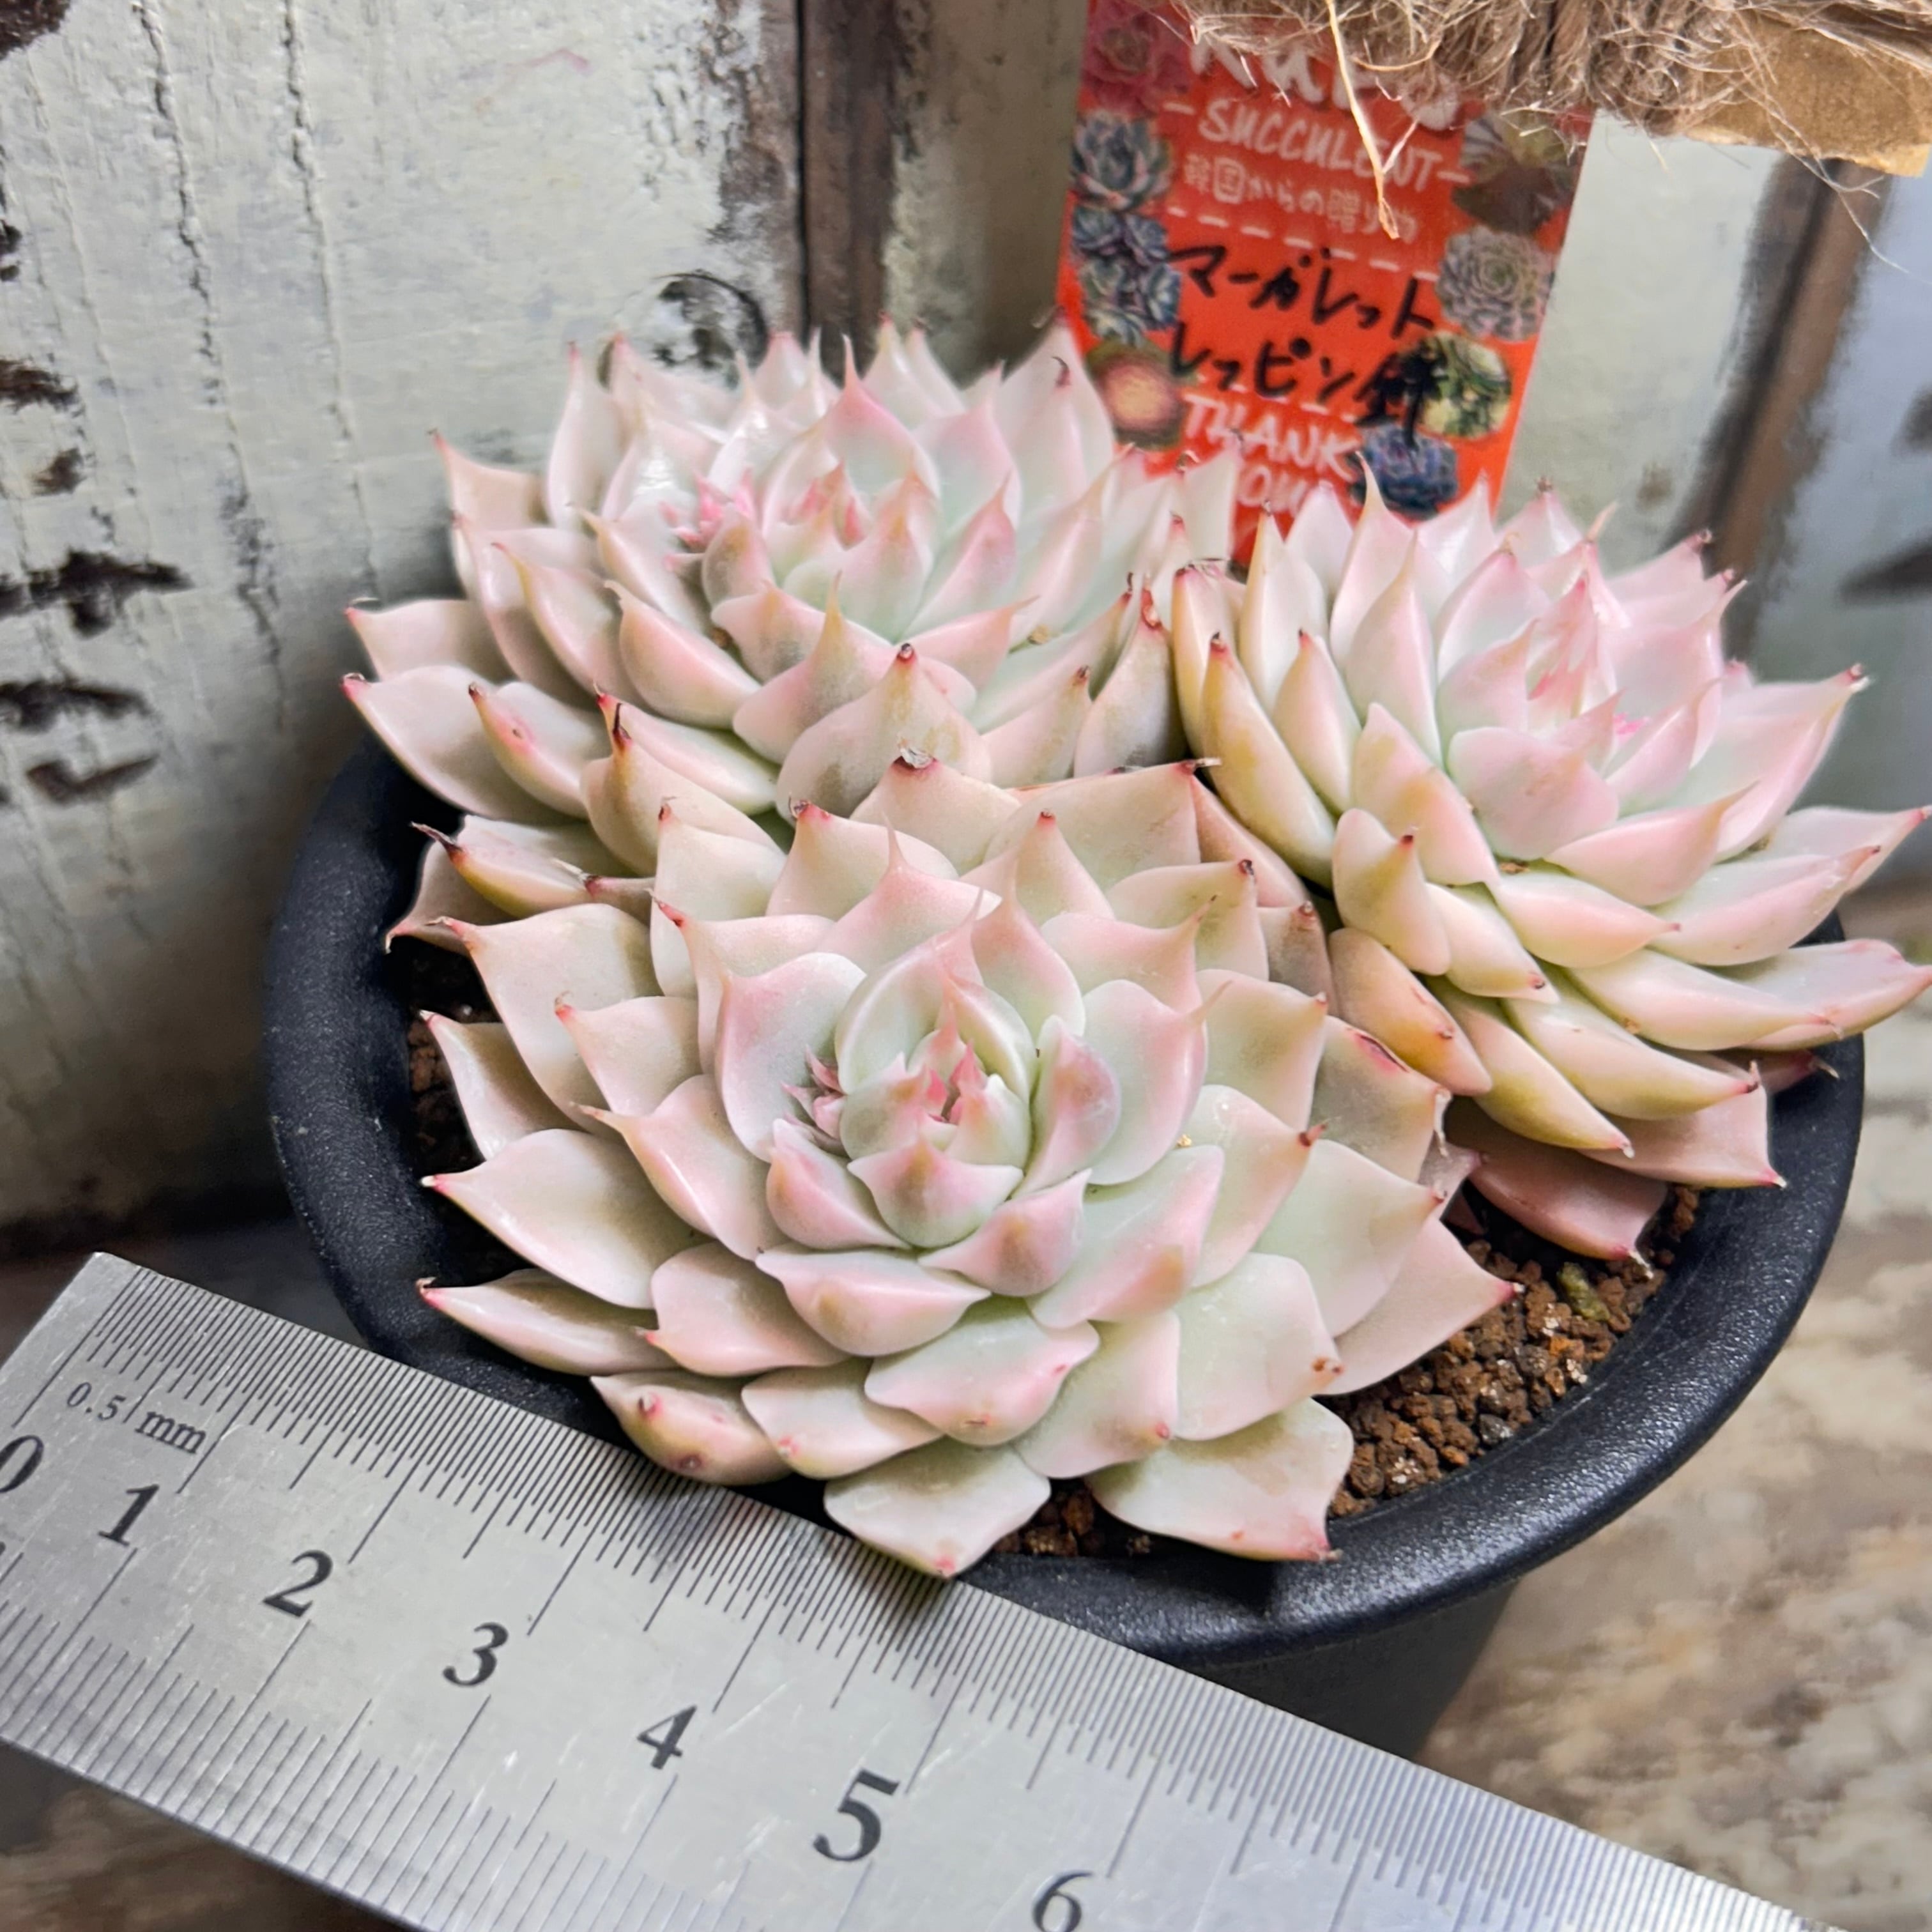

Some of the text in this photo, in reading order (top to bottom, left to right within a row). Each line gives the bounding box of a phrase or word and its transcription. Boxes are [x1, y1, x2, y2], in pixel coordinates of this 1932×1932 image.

[1199, 98, 1443, 192] SUCCULENT
[1168, 245, 1435, 339] マーガレット
[1183, 394, 1361, 484] THANK
[1236, 464, 1308, 517] OU
[67, 1382, 206, 1454] 0.5 mm
[0, 1434, 1094, 1932] 0 1 2 3 4 5 6
